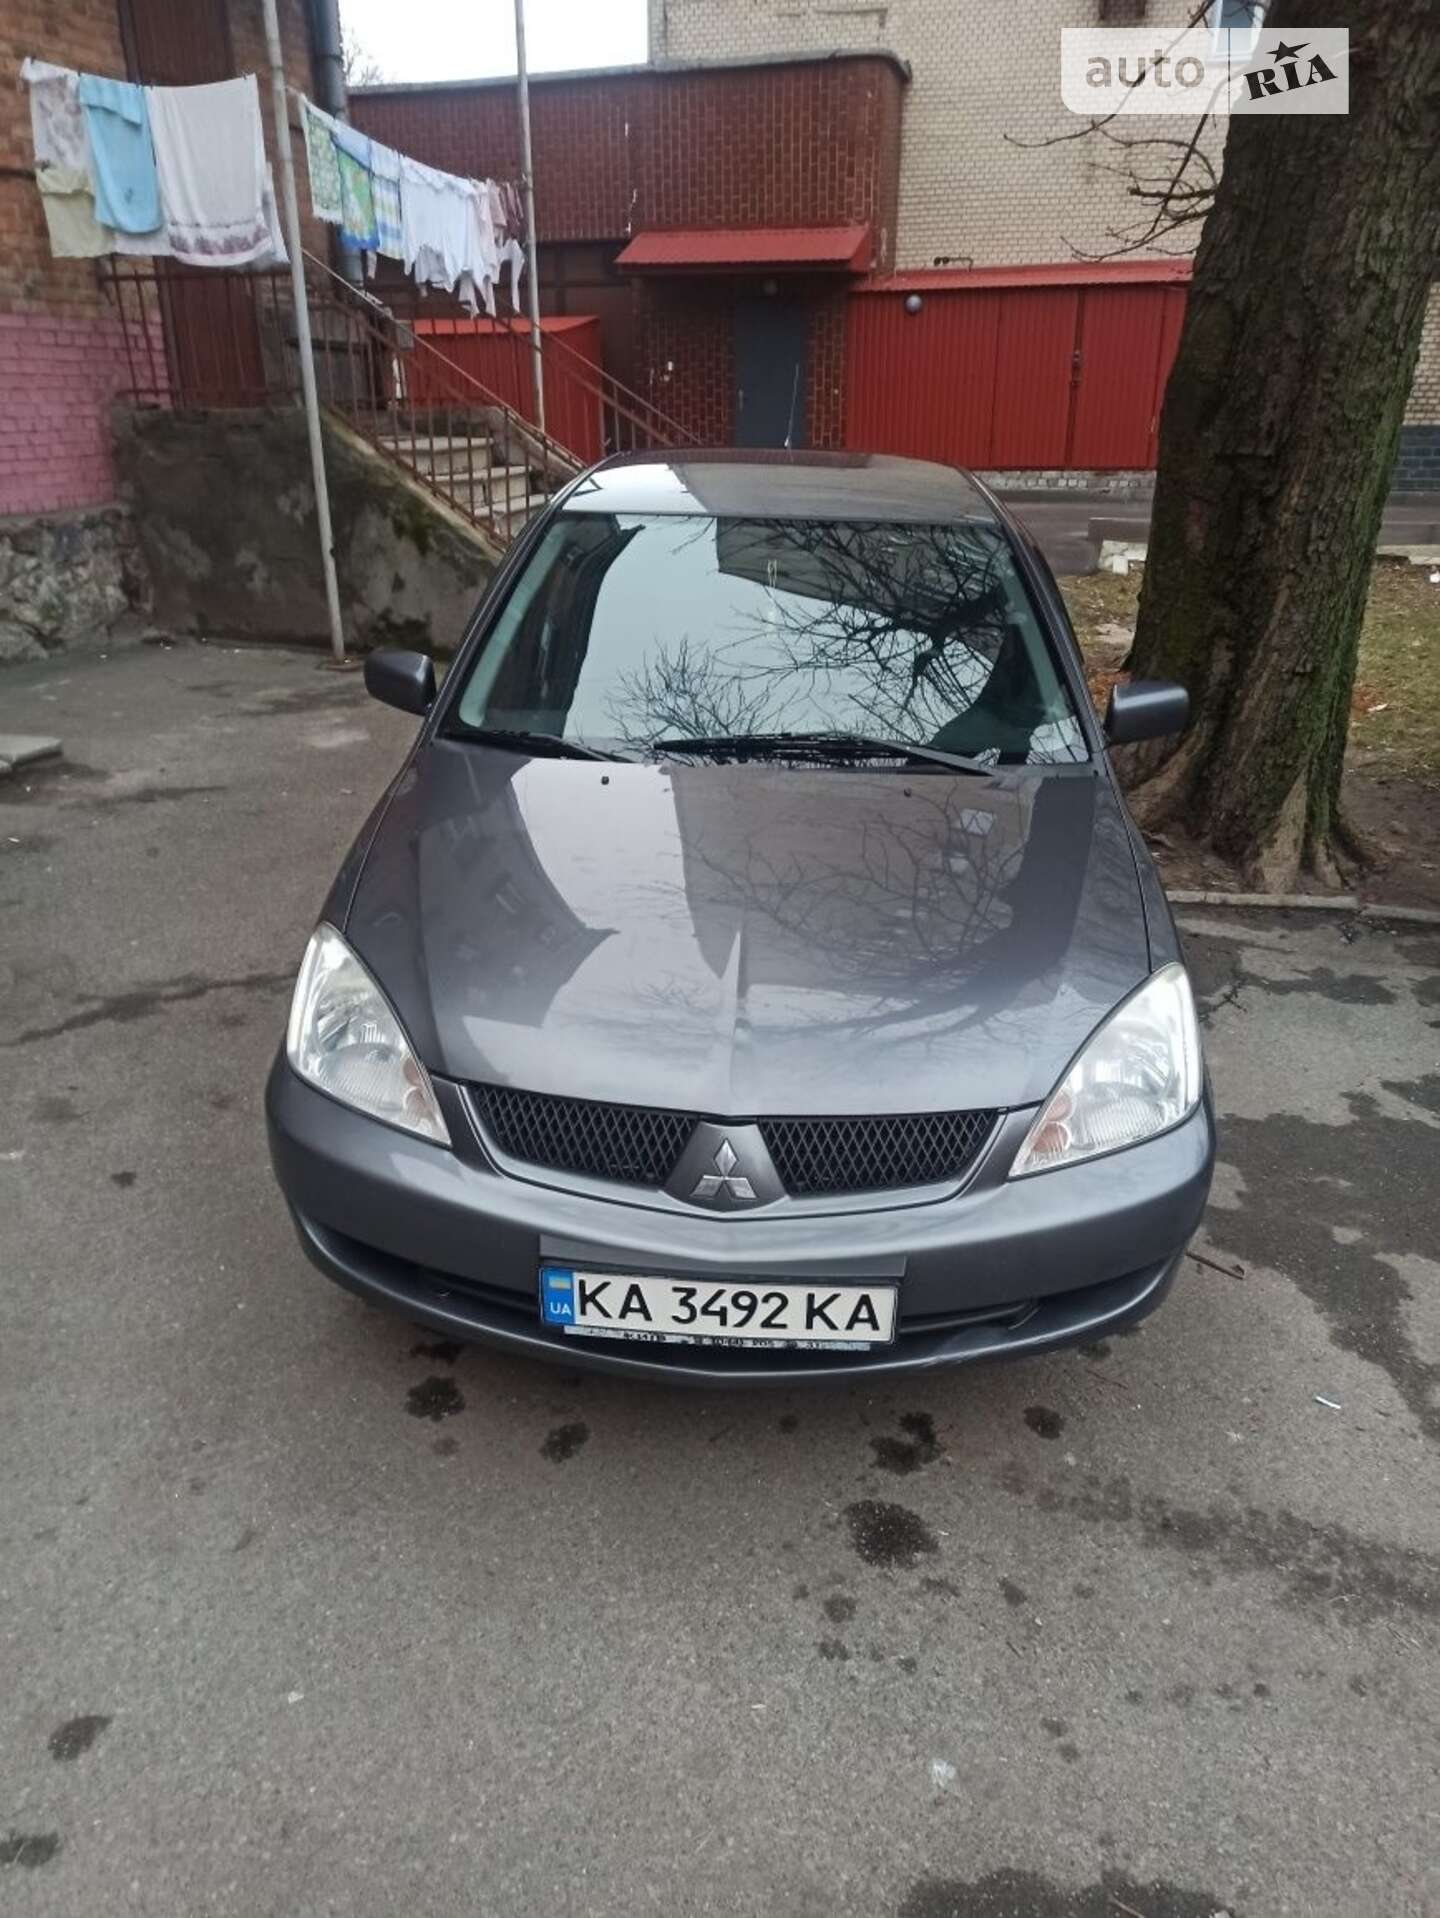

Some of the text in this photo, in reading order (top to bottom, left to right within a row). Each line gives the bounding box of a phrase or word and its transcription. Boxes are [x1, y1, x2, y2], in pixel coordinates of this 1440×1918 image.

[550, 1303, 571, 1315] UA
[578, 1279, 881, 1331] KA 3492 KA
